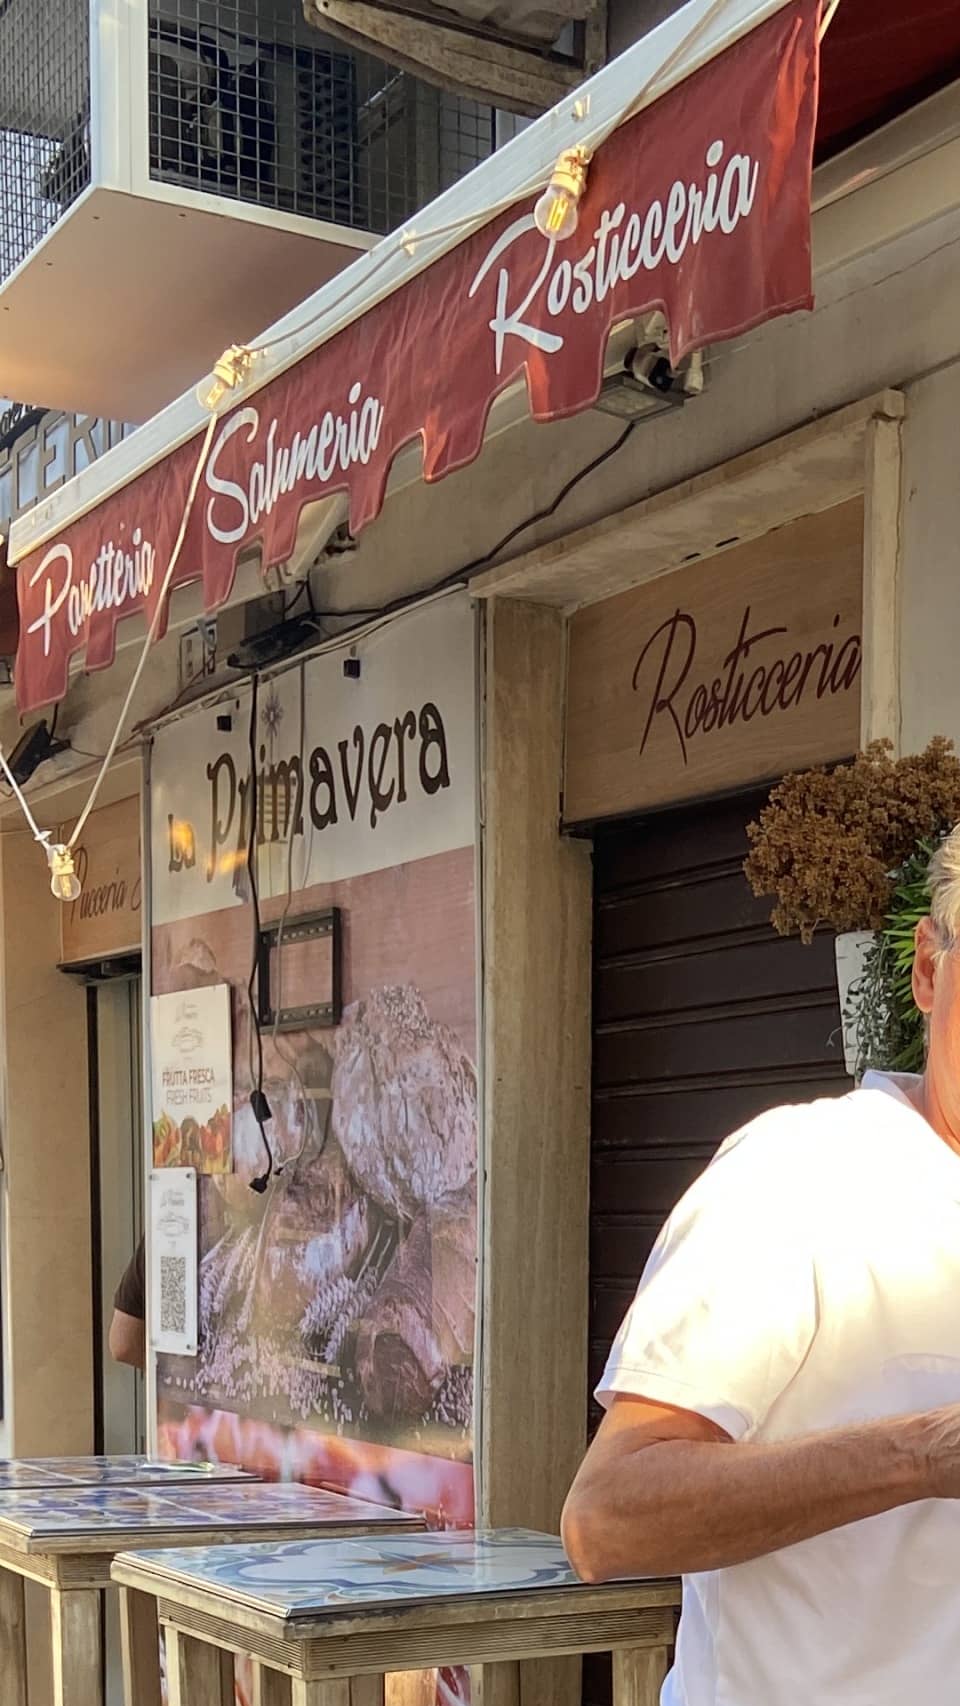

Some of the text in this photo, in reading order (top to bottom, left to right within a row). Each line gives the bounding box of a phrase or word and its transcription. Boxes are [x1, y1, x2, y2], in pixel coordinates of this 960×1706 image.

[468, 139, 759, 376] Rosticceria
[205, 382, 385, 544] Salumeria
[632, 605, 863, 767] Rosticceria
